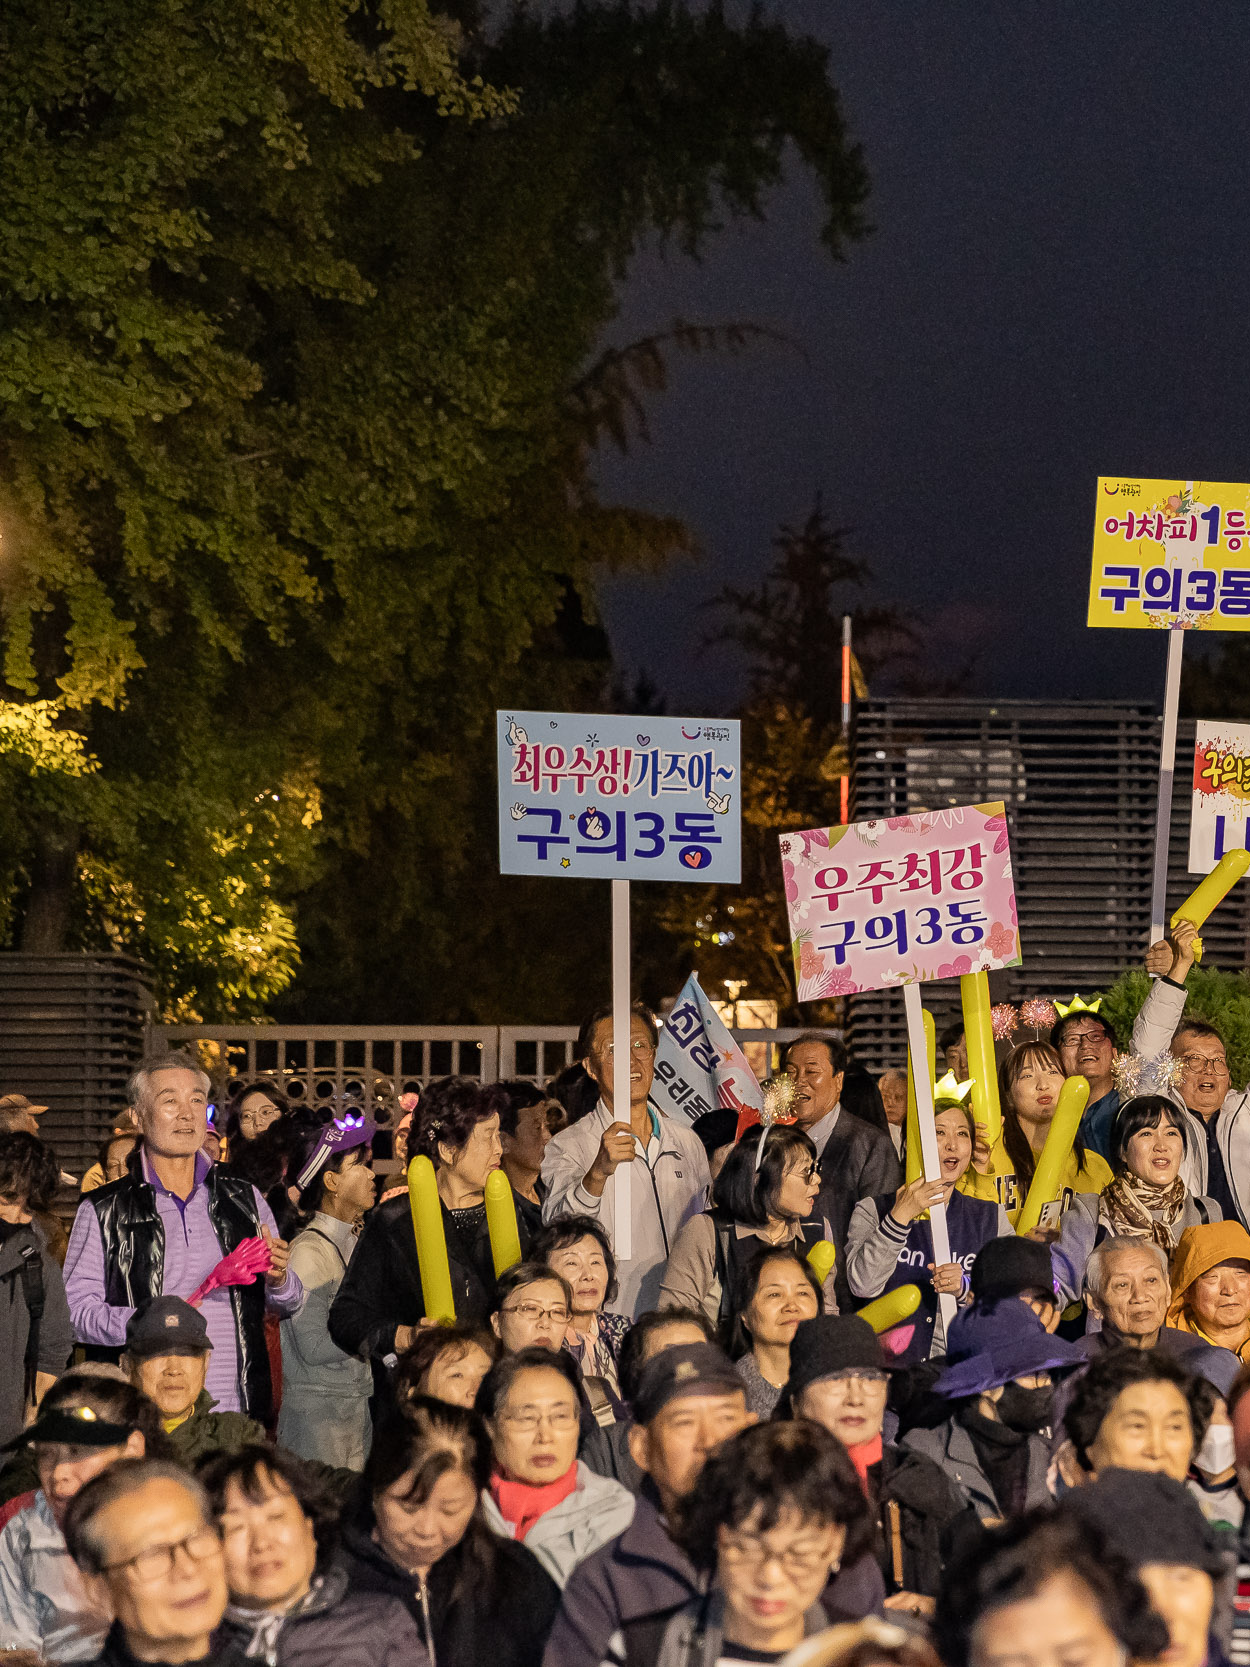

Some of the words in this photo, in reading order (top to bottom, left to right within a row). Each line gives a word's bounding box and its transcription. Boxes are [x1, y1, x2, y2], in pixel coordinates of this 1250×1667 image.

[517, 808, 722, 870] 구의3동
[811, 843, 987, 912] 우주최강
[817, 899, 988, 965] 구의3동
